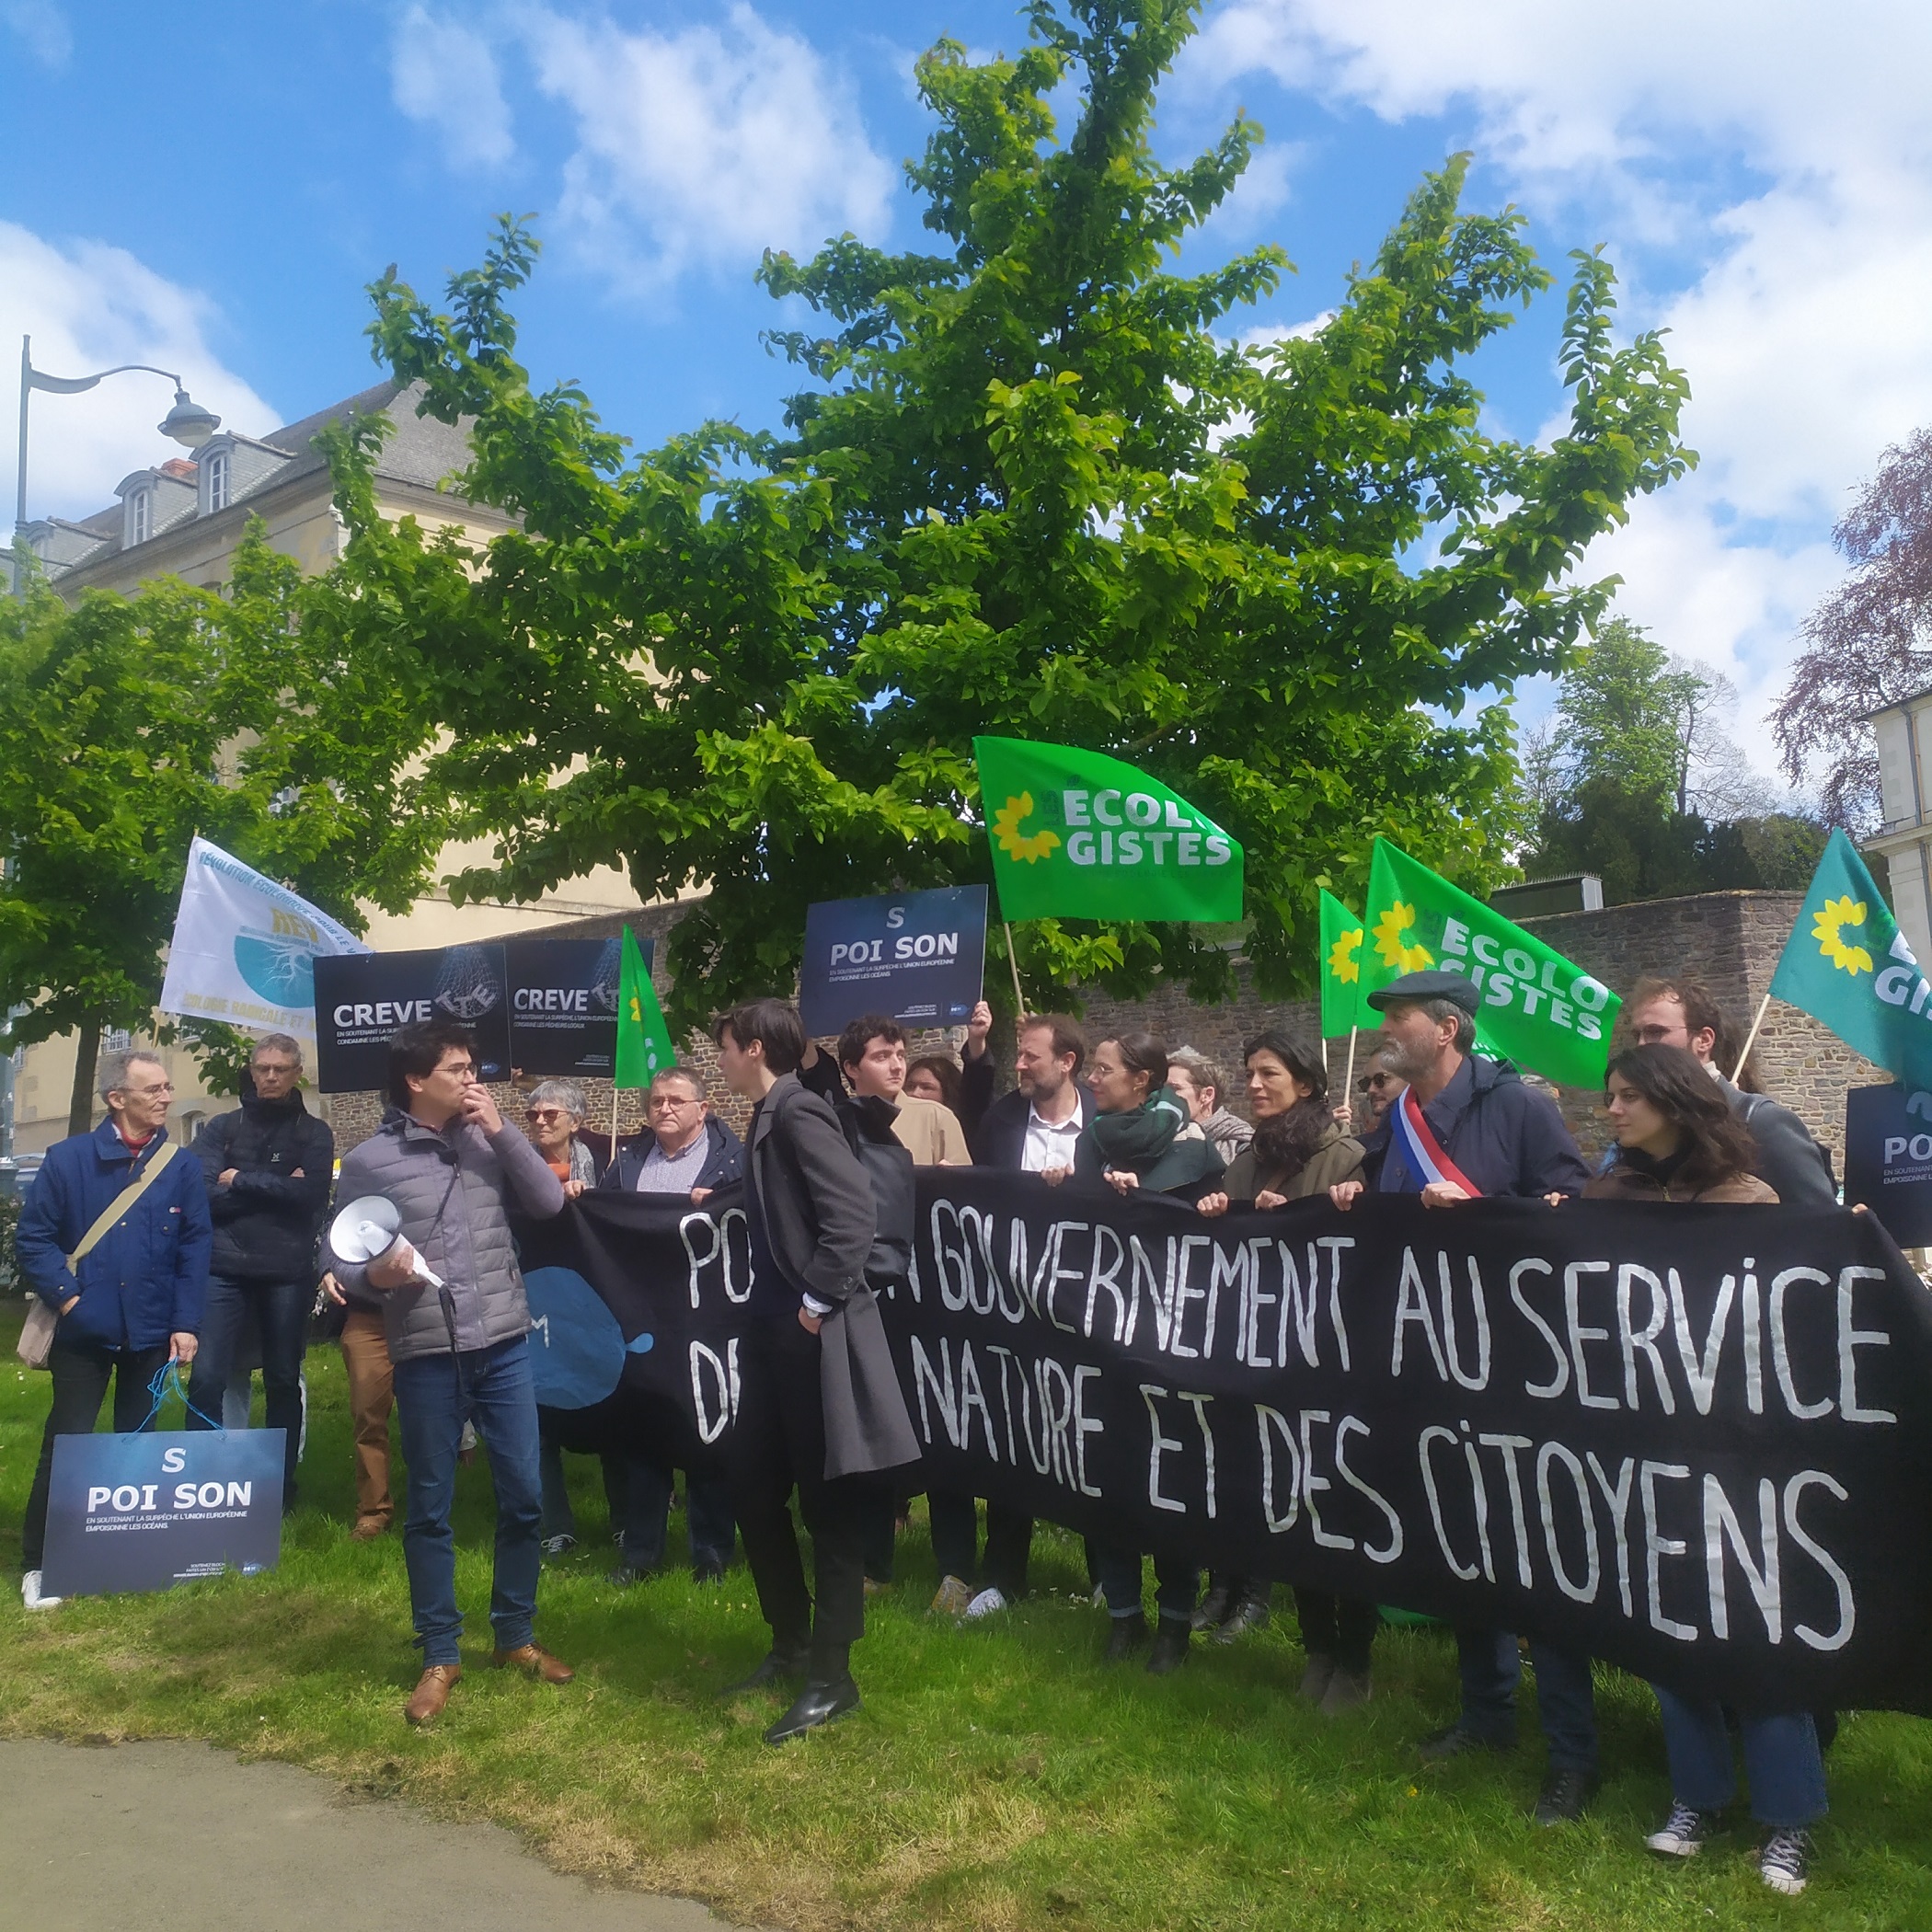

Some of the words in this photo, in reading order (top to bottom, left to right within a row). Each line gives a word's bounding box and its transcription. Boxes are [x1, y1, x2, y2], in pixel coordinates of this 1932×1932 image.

[1067, 831, 1232, 866] GISTES
[886, 906, 906, 929] S
[831, 939, 884, 966] POI
[894, 932, 959, 960] SON
[836, 967, 866, 975] SOUTENANT
[337, 1037, 369, 1045] CONDAMNE
[345, 1029, 378, 1038] SOUTENANT
[931, 1198, 1356, 1372] GOUVERNEMENT
[1391, 1245, 1491, 1391] AU
[162, 1447, 187, 1473] S
[910, 1336, 1103, 1498] NATURE
[1139, 1384, 1218, 1520] ET
[1255, 1403, 1405, 1564] DES
[87, 1485, 159, 1512] POI
[173, 1481, 252, 1509] SON
[85, 1524, 129, 1533] EMPOISONNE
[129, 1523, 142, 1531] LES
[96, 1515, 136, 1524] SOUTENANT
[135, 1514, 145, 1523] LA
[206, 1510, 248, 1519] EUROPÉENNE
